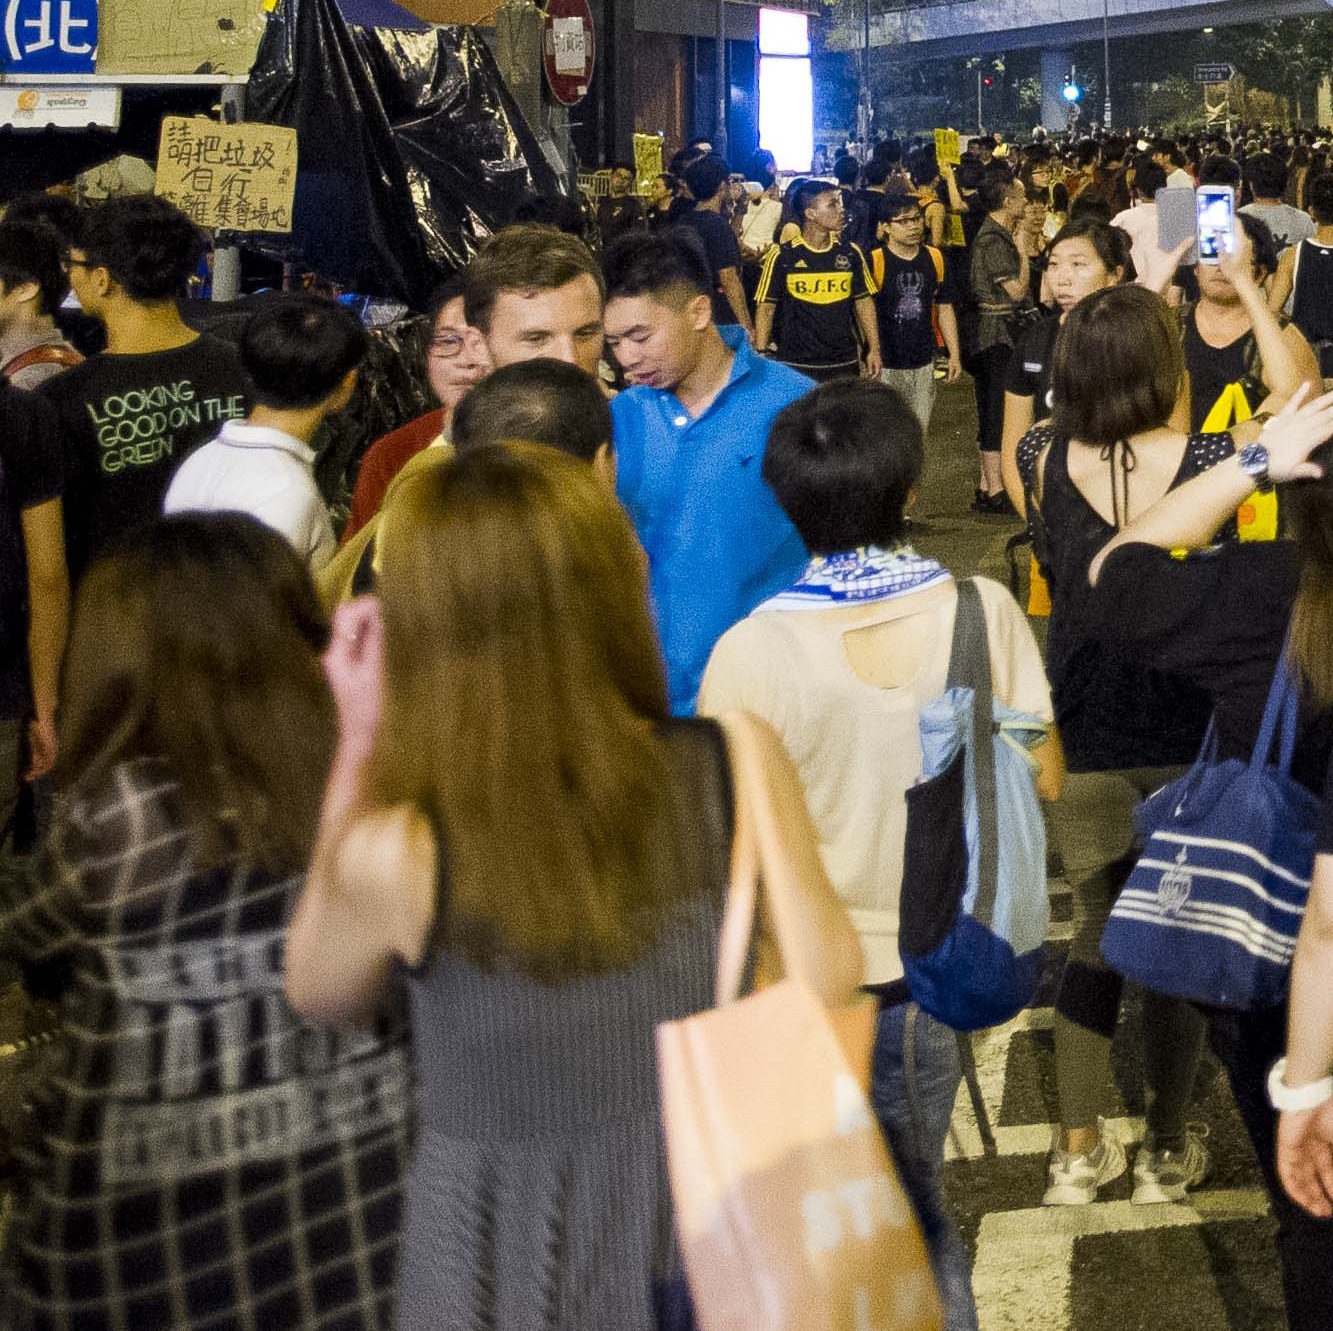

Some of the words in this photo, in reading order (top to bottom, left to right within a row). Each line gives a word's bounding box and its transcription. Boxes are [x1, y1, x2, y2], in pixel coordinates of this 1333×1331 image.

[167, 121, 276, 170] 請把垃圾
[181, 166, 252, 199] 自行
[86, 380, 196, 424] LOOKING
[98, 412, 167, 448] GOOD
[169, 402, 201, 428] ON
[203, 395, 245, 421] THE
[101, 434, 174, 472] GREEN
